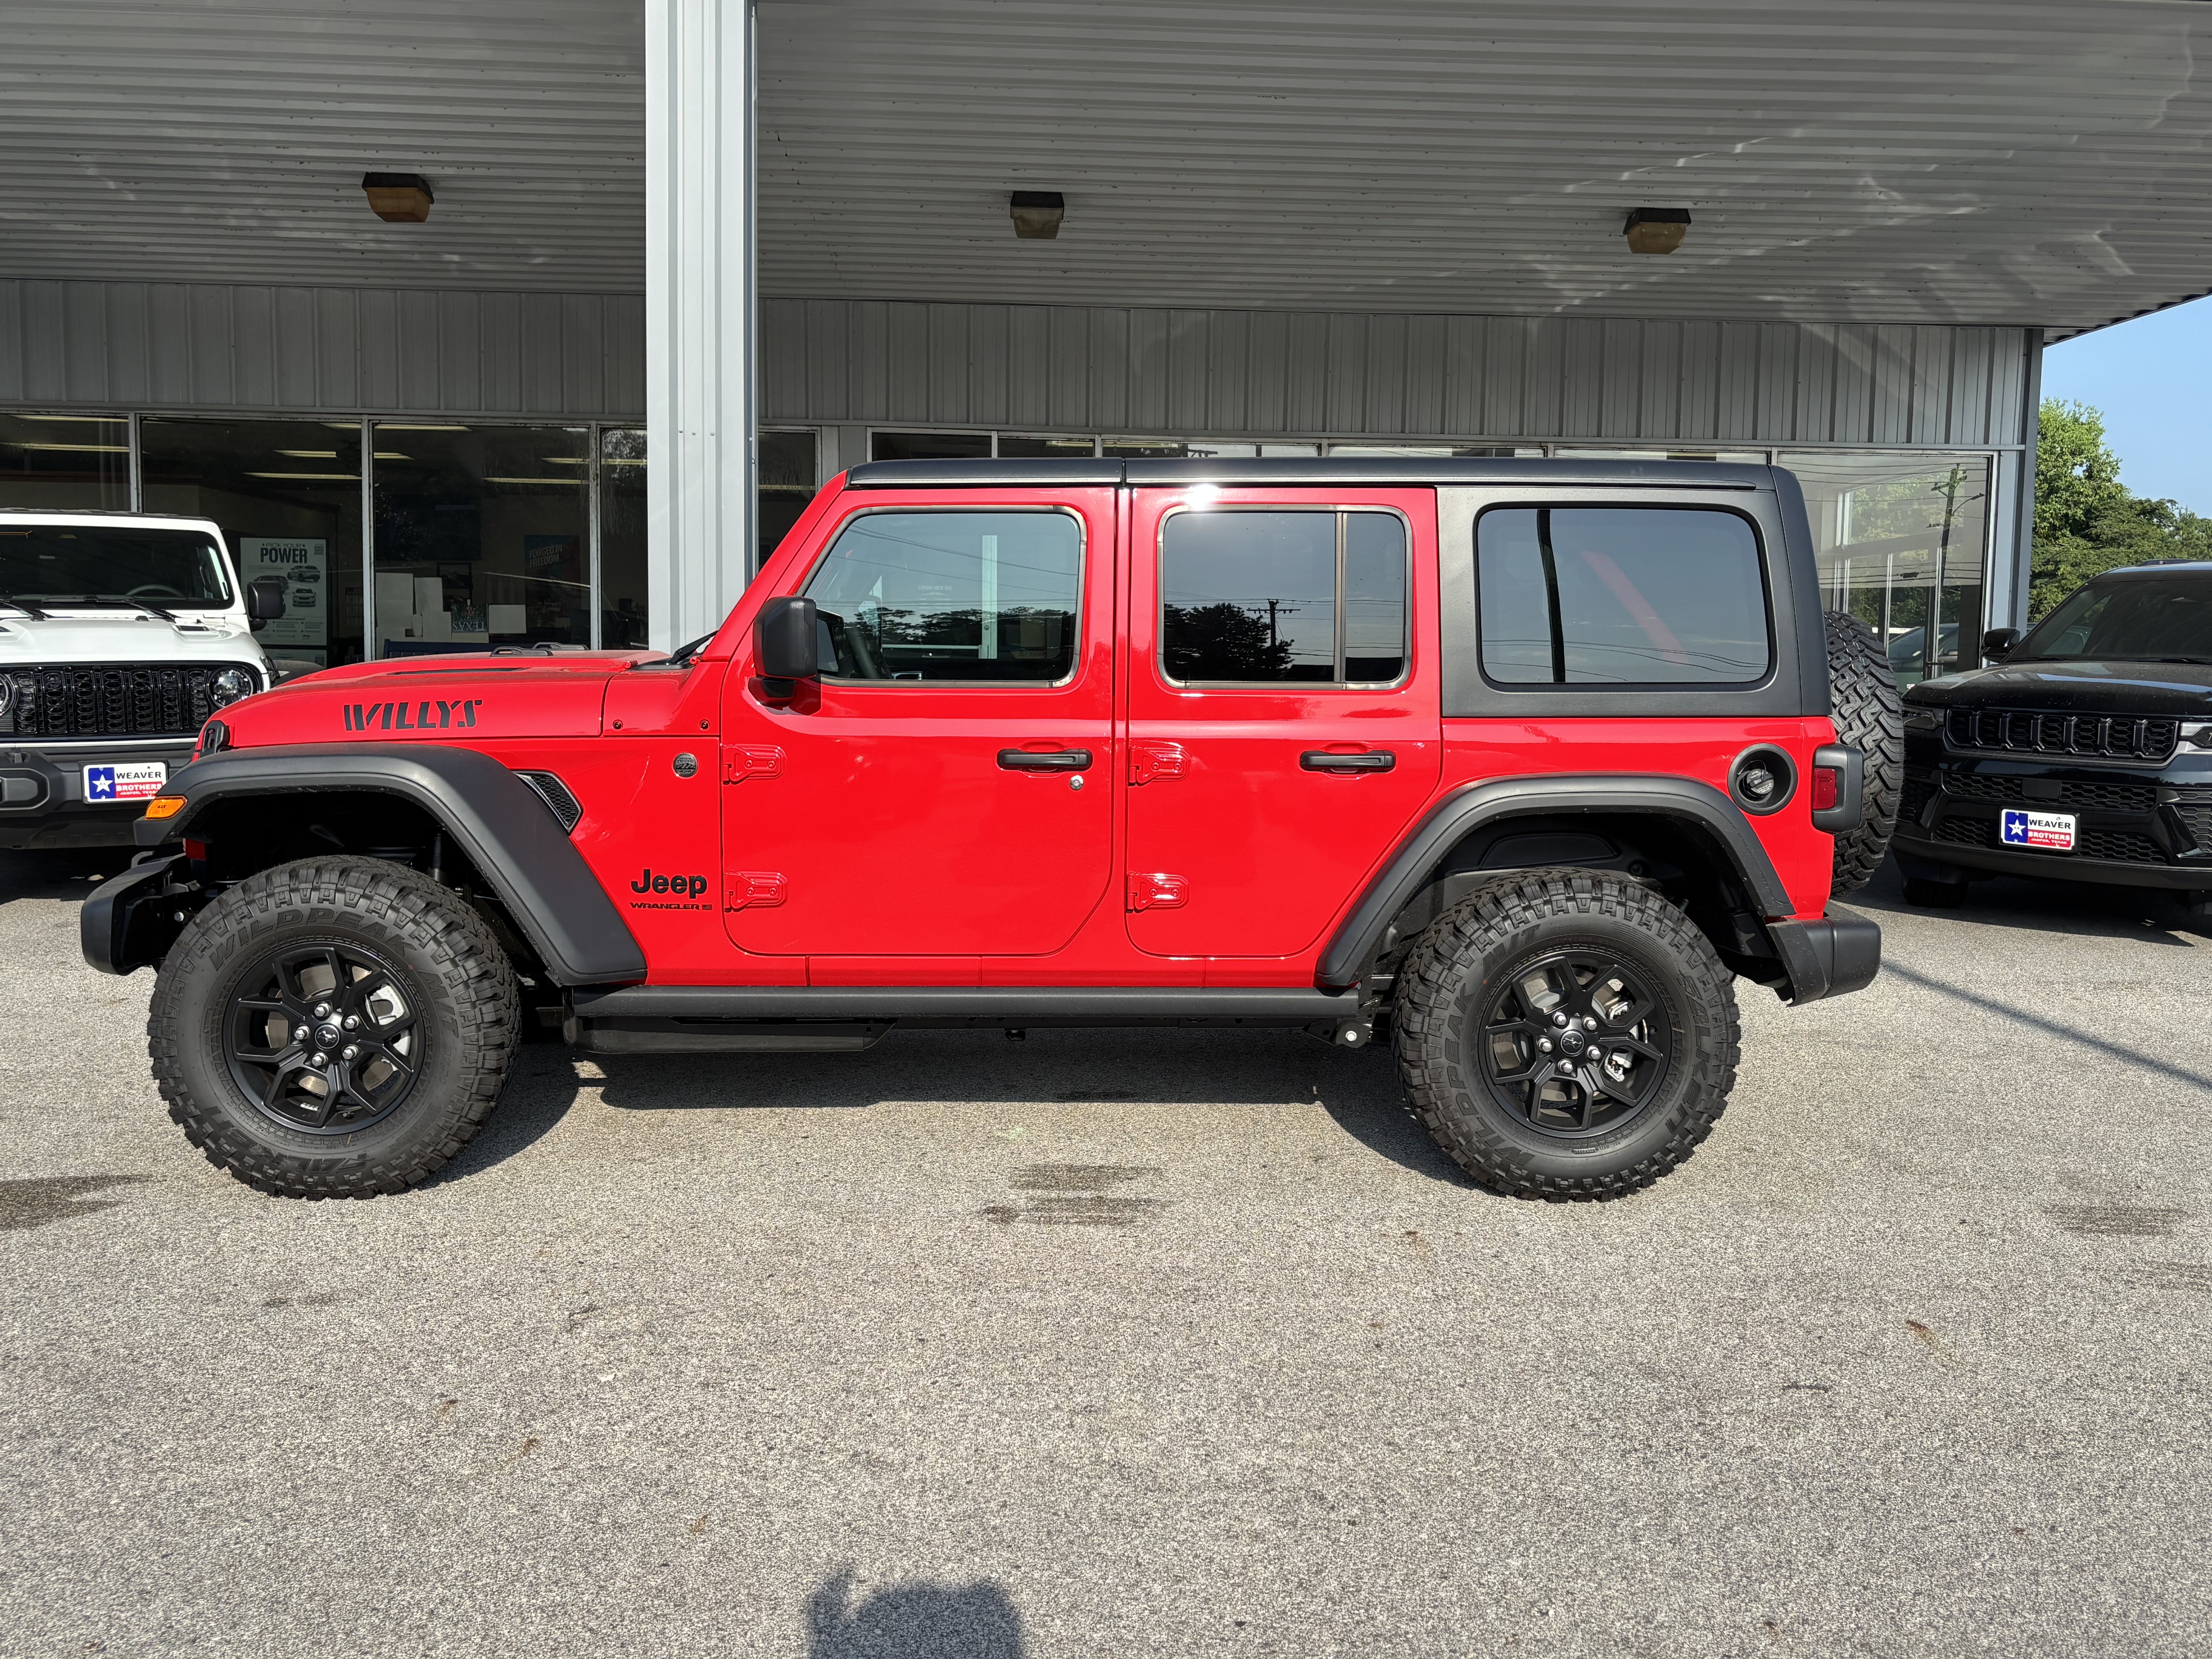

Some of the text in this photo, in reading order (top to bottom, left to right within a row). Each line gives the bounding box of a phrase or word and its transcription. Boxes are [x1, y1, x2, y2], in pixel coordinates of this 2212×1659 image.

[260, 548, 307, 563] POWER
[530, 544, 563, 558] FORGED IN
[452, 621, 487, 632] TEXAS
[344, 700, 483, 731] WILLYS
[116, 783, 162, 792] BROTHERS
[2028, 831, 2070, 841] BROTHERS
[2029, 819, 2071, 830] WEAVER
[631, 869, 707, 899] Jeep
[1483, 923, 1540, 975] M/T
[209, 907, 459, 1038] WILDPEAK M/T
[1666, 975, 1710, 1134] FALKEN
[1445, 983, 1535, 1166] WILDPEAK
[205, 1106, 375, 1174] FALKEN
